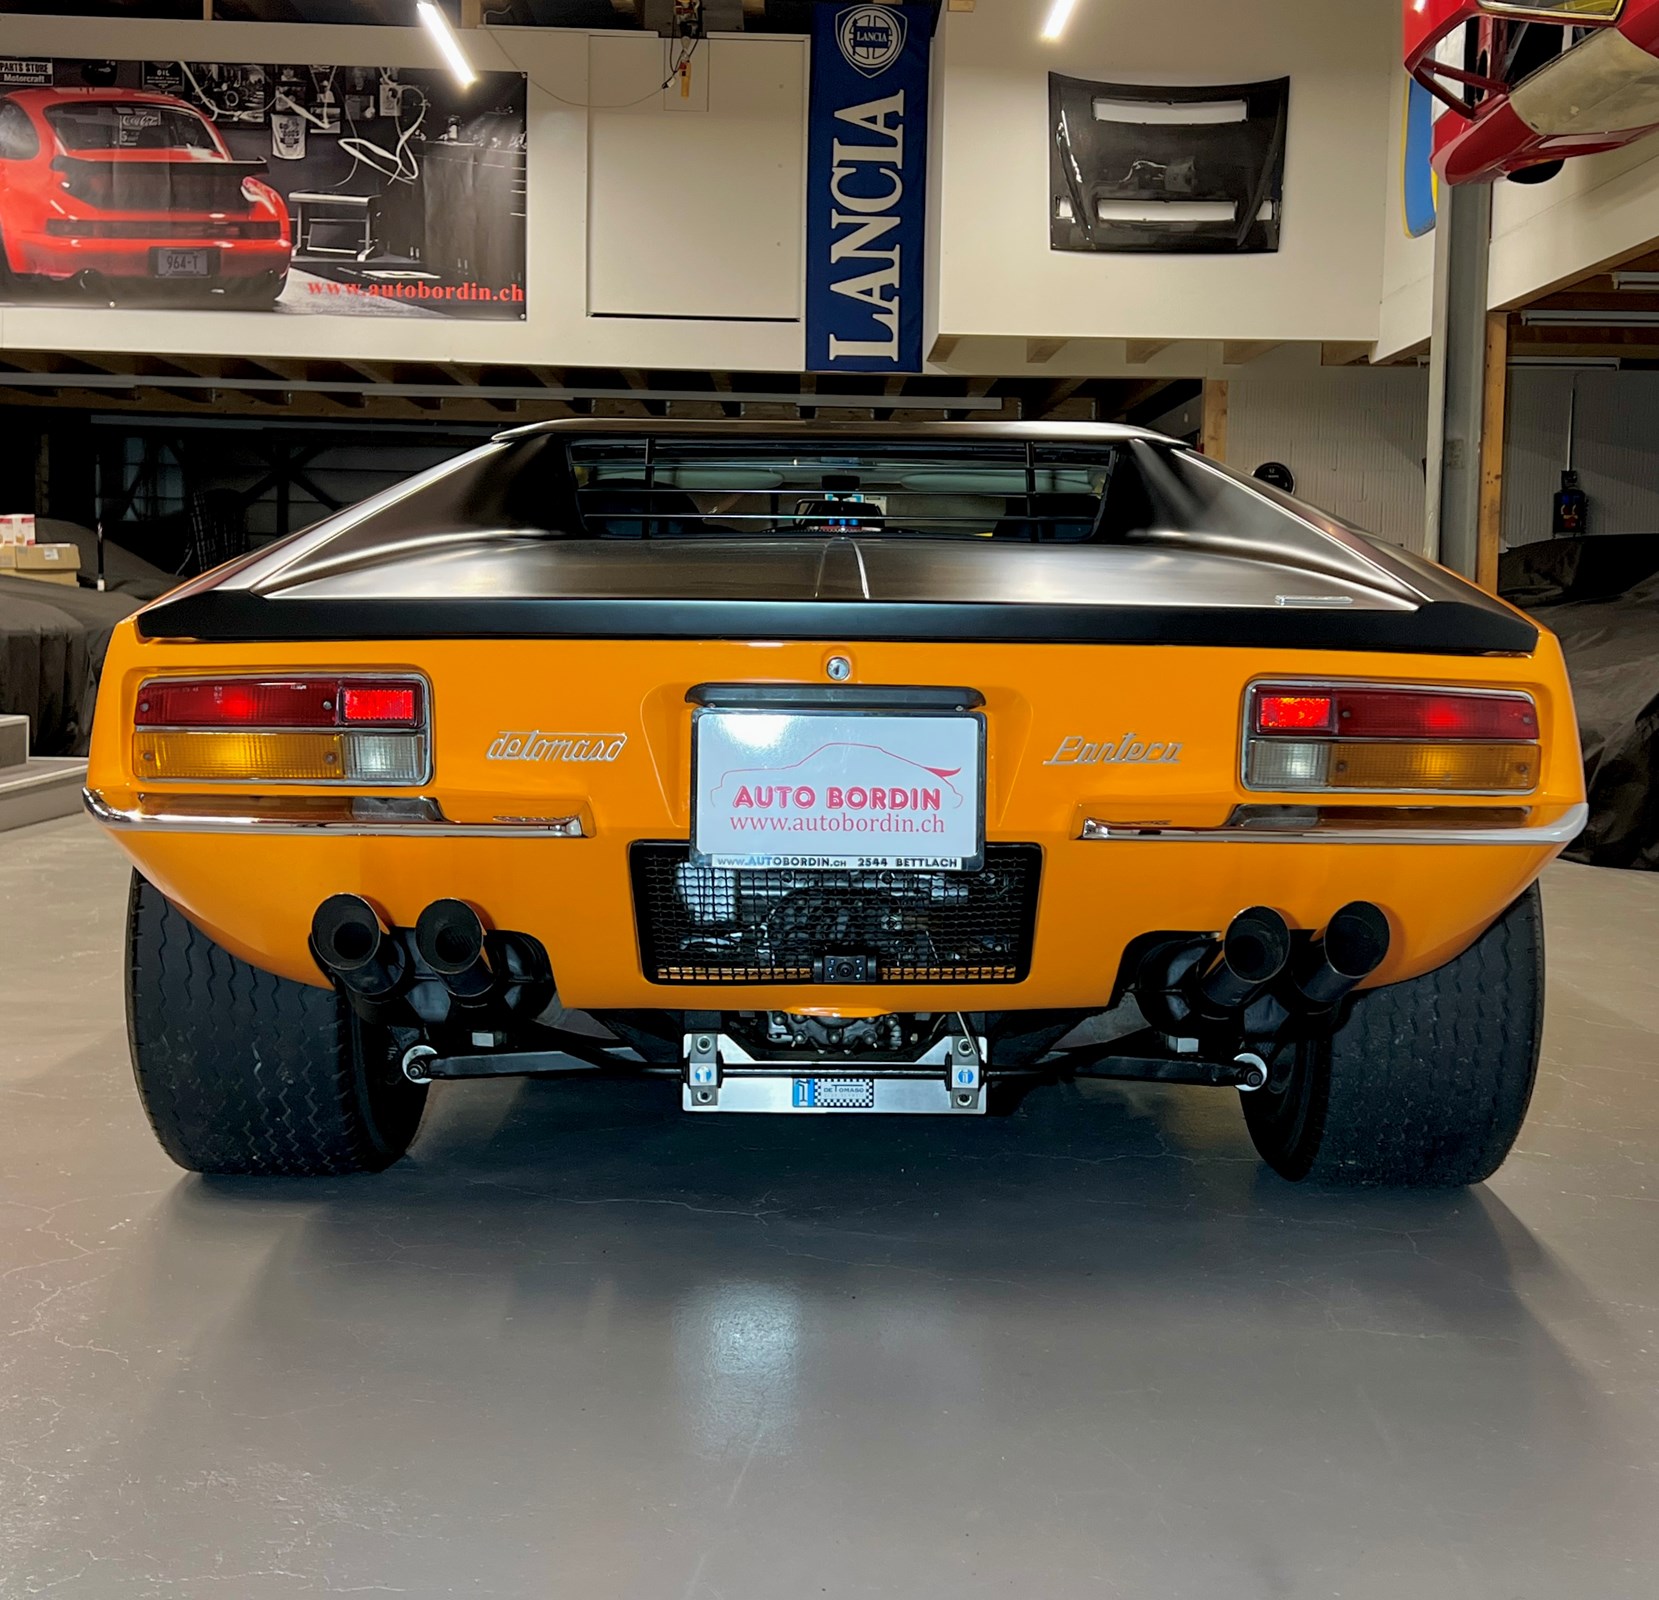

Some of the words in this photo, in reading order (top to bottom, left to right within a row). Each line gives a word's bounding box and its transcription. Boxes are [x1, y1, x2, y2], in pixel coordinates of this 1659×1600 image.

[856, 31, 887, 43] LANCIA
[4, 73, 45, 83] Motorcraft
[829, 89, 904, 362] LANCIA
[166, 255, 199, 270] 964-T
[307, 281, 524, 301] www.autobordin.ch
[1042, 732, 1184, 765] Pantera
[733, 785, 816, 809] AUTO
[825, 786, 941, 811] BORDIN
[730, 812, 945, 833] www.autobordin.ch
[857, 857, 888, 868] 2544
[895, 858, 958, 868] BETTLACH
